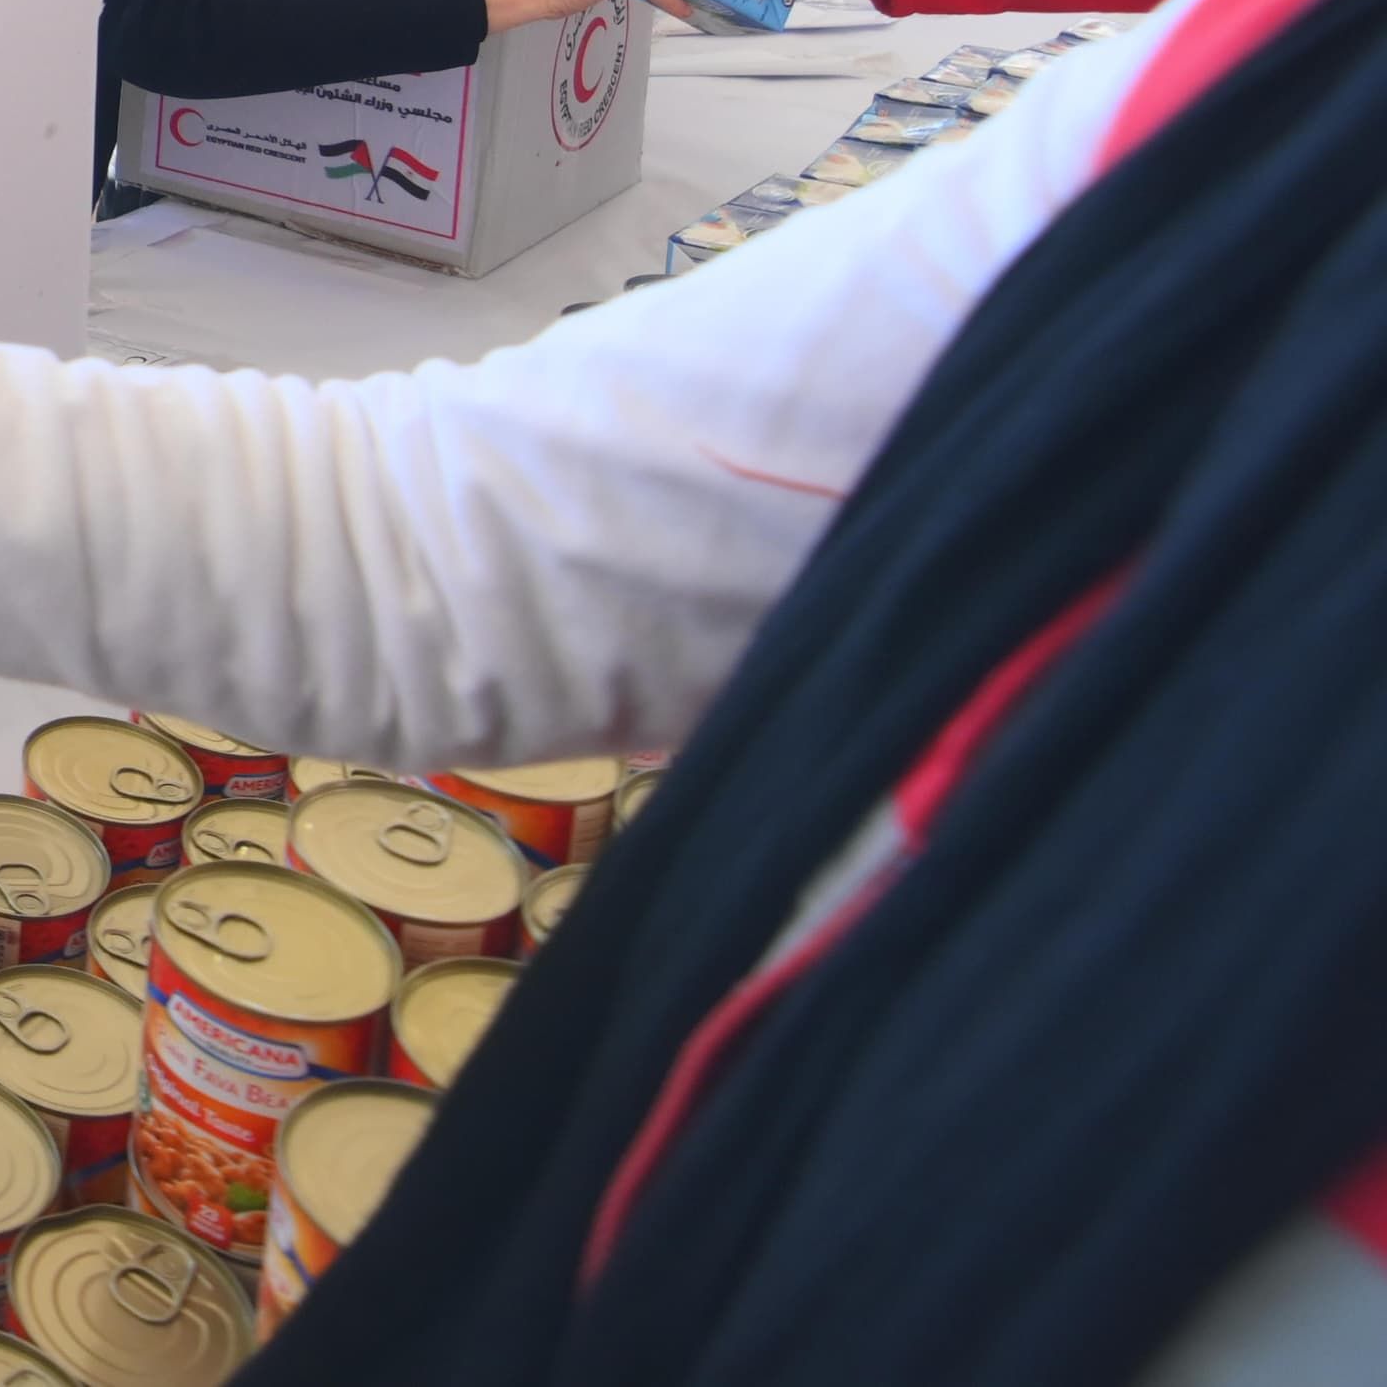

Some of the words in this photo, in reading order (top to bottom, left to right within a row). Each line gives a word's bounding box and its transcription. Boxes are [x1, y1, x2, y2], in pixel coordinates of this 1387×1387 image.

[363, 96, 394, 113] وزراء
[398, 106, 453, 124] مجلسي
[173, 1000, 301, 1065] AMERICANA
[245, 1084, 290, 1110] BEA
